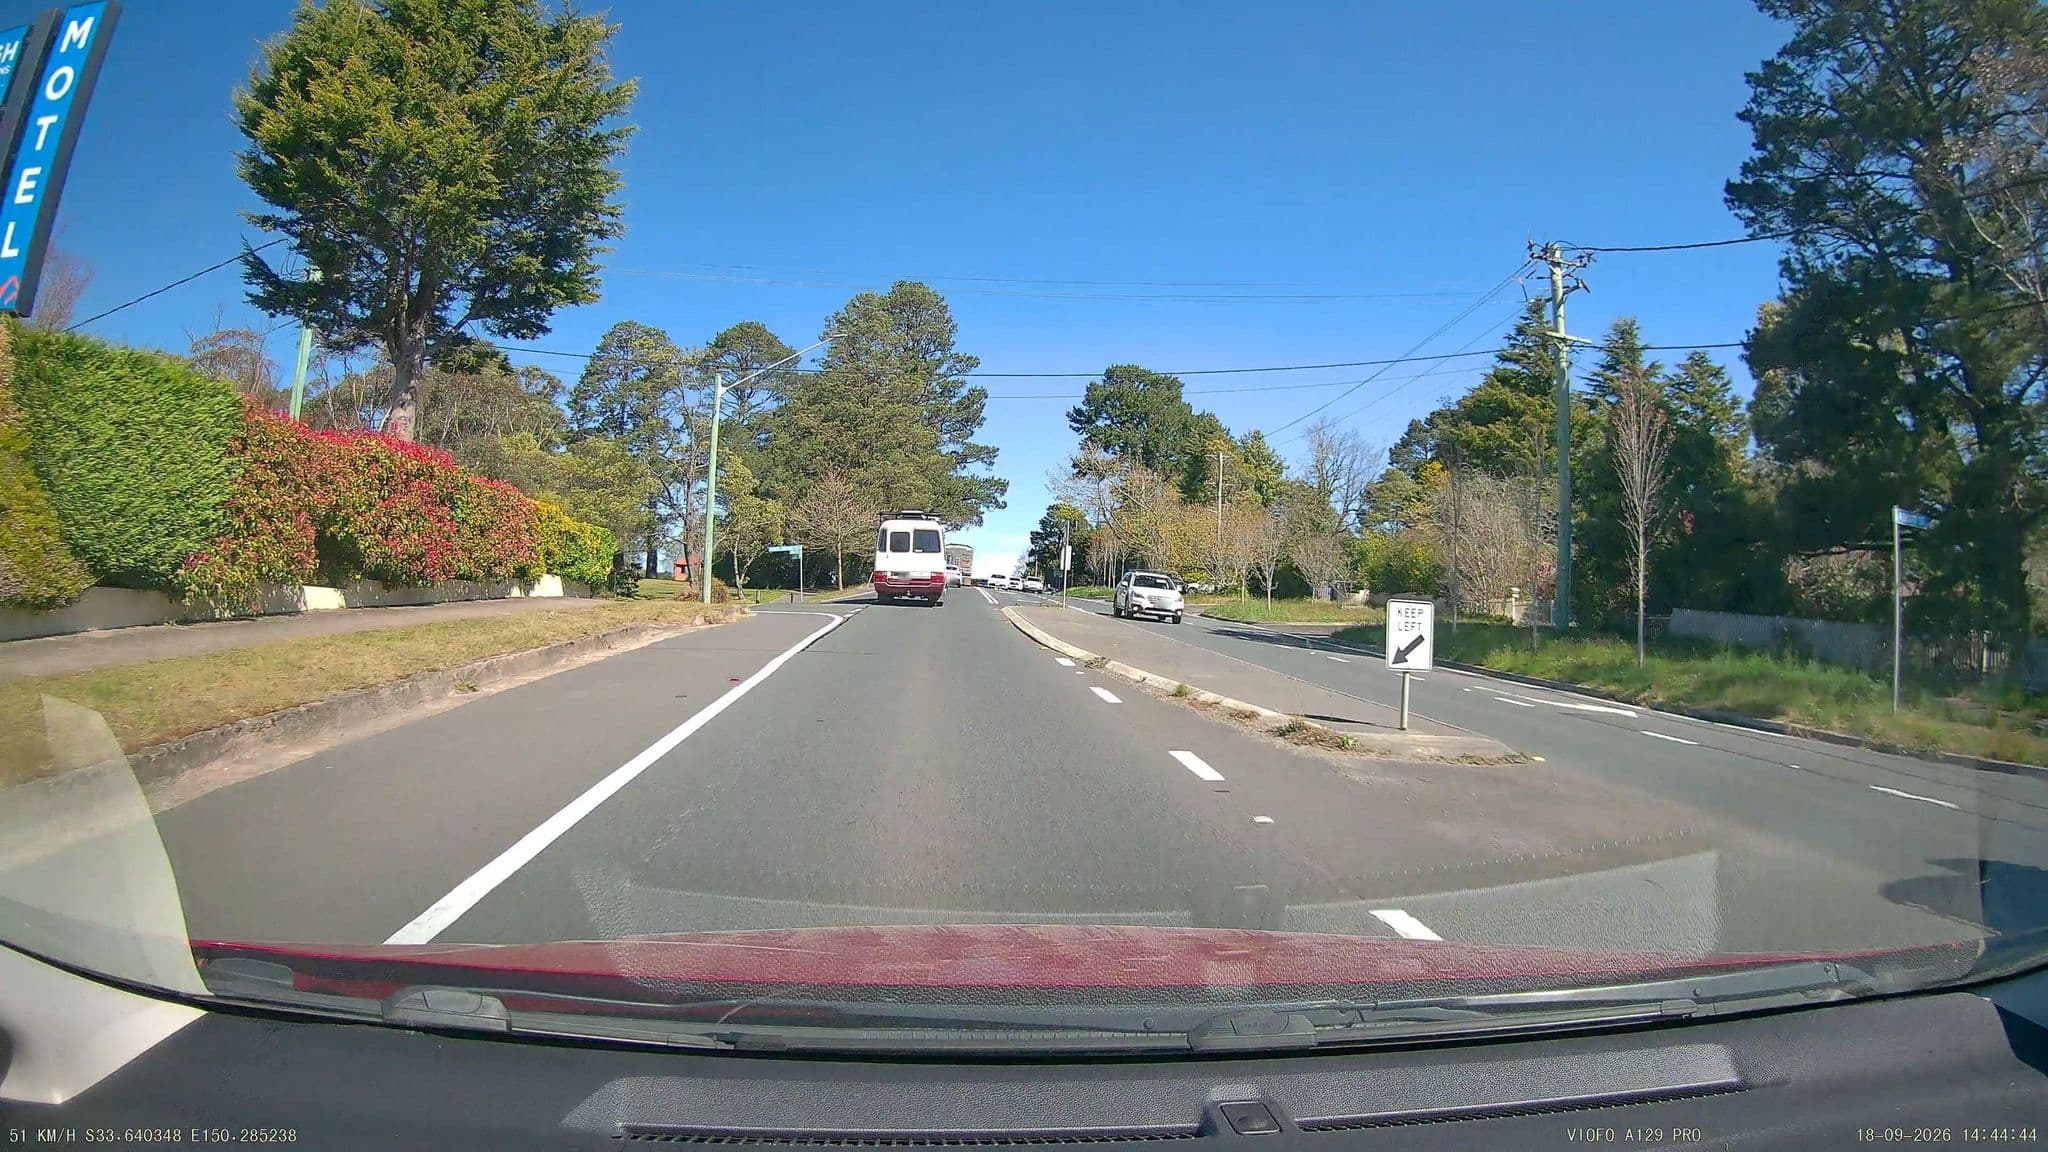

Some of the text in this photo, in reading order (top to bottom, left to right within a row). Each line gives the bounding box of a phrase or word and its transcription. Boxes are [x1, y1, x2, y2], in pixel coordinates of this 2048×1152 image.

[1, 16, 95, 259] MOTEL
[1397, 607, 1424, 619] KEEP
[1397, 621, 1422, 632] LEFT
